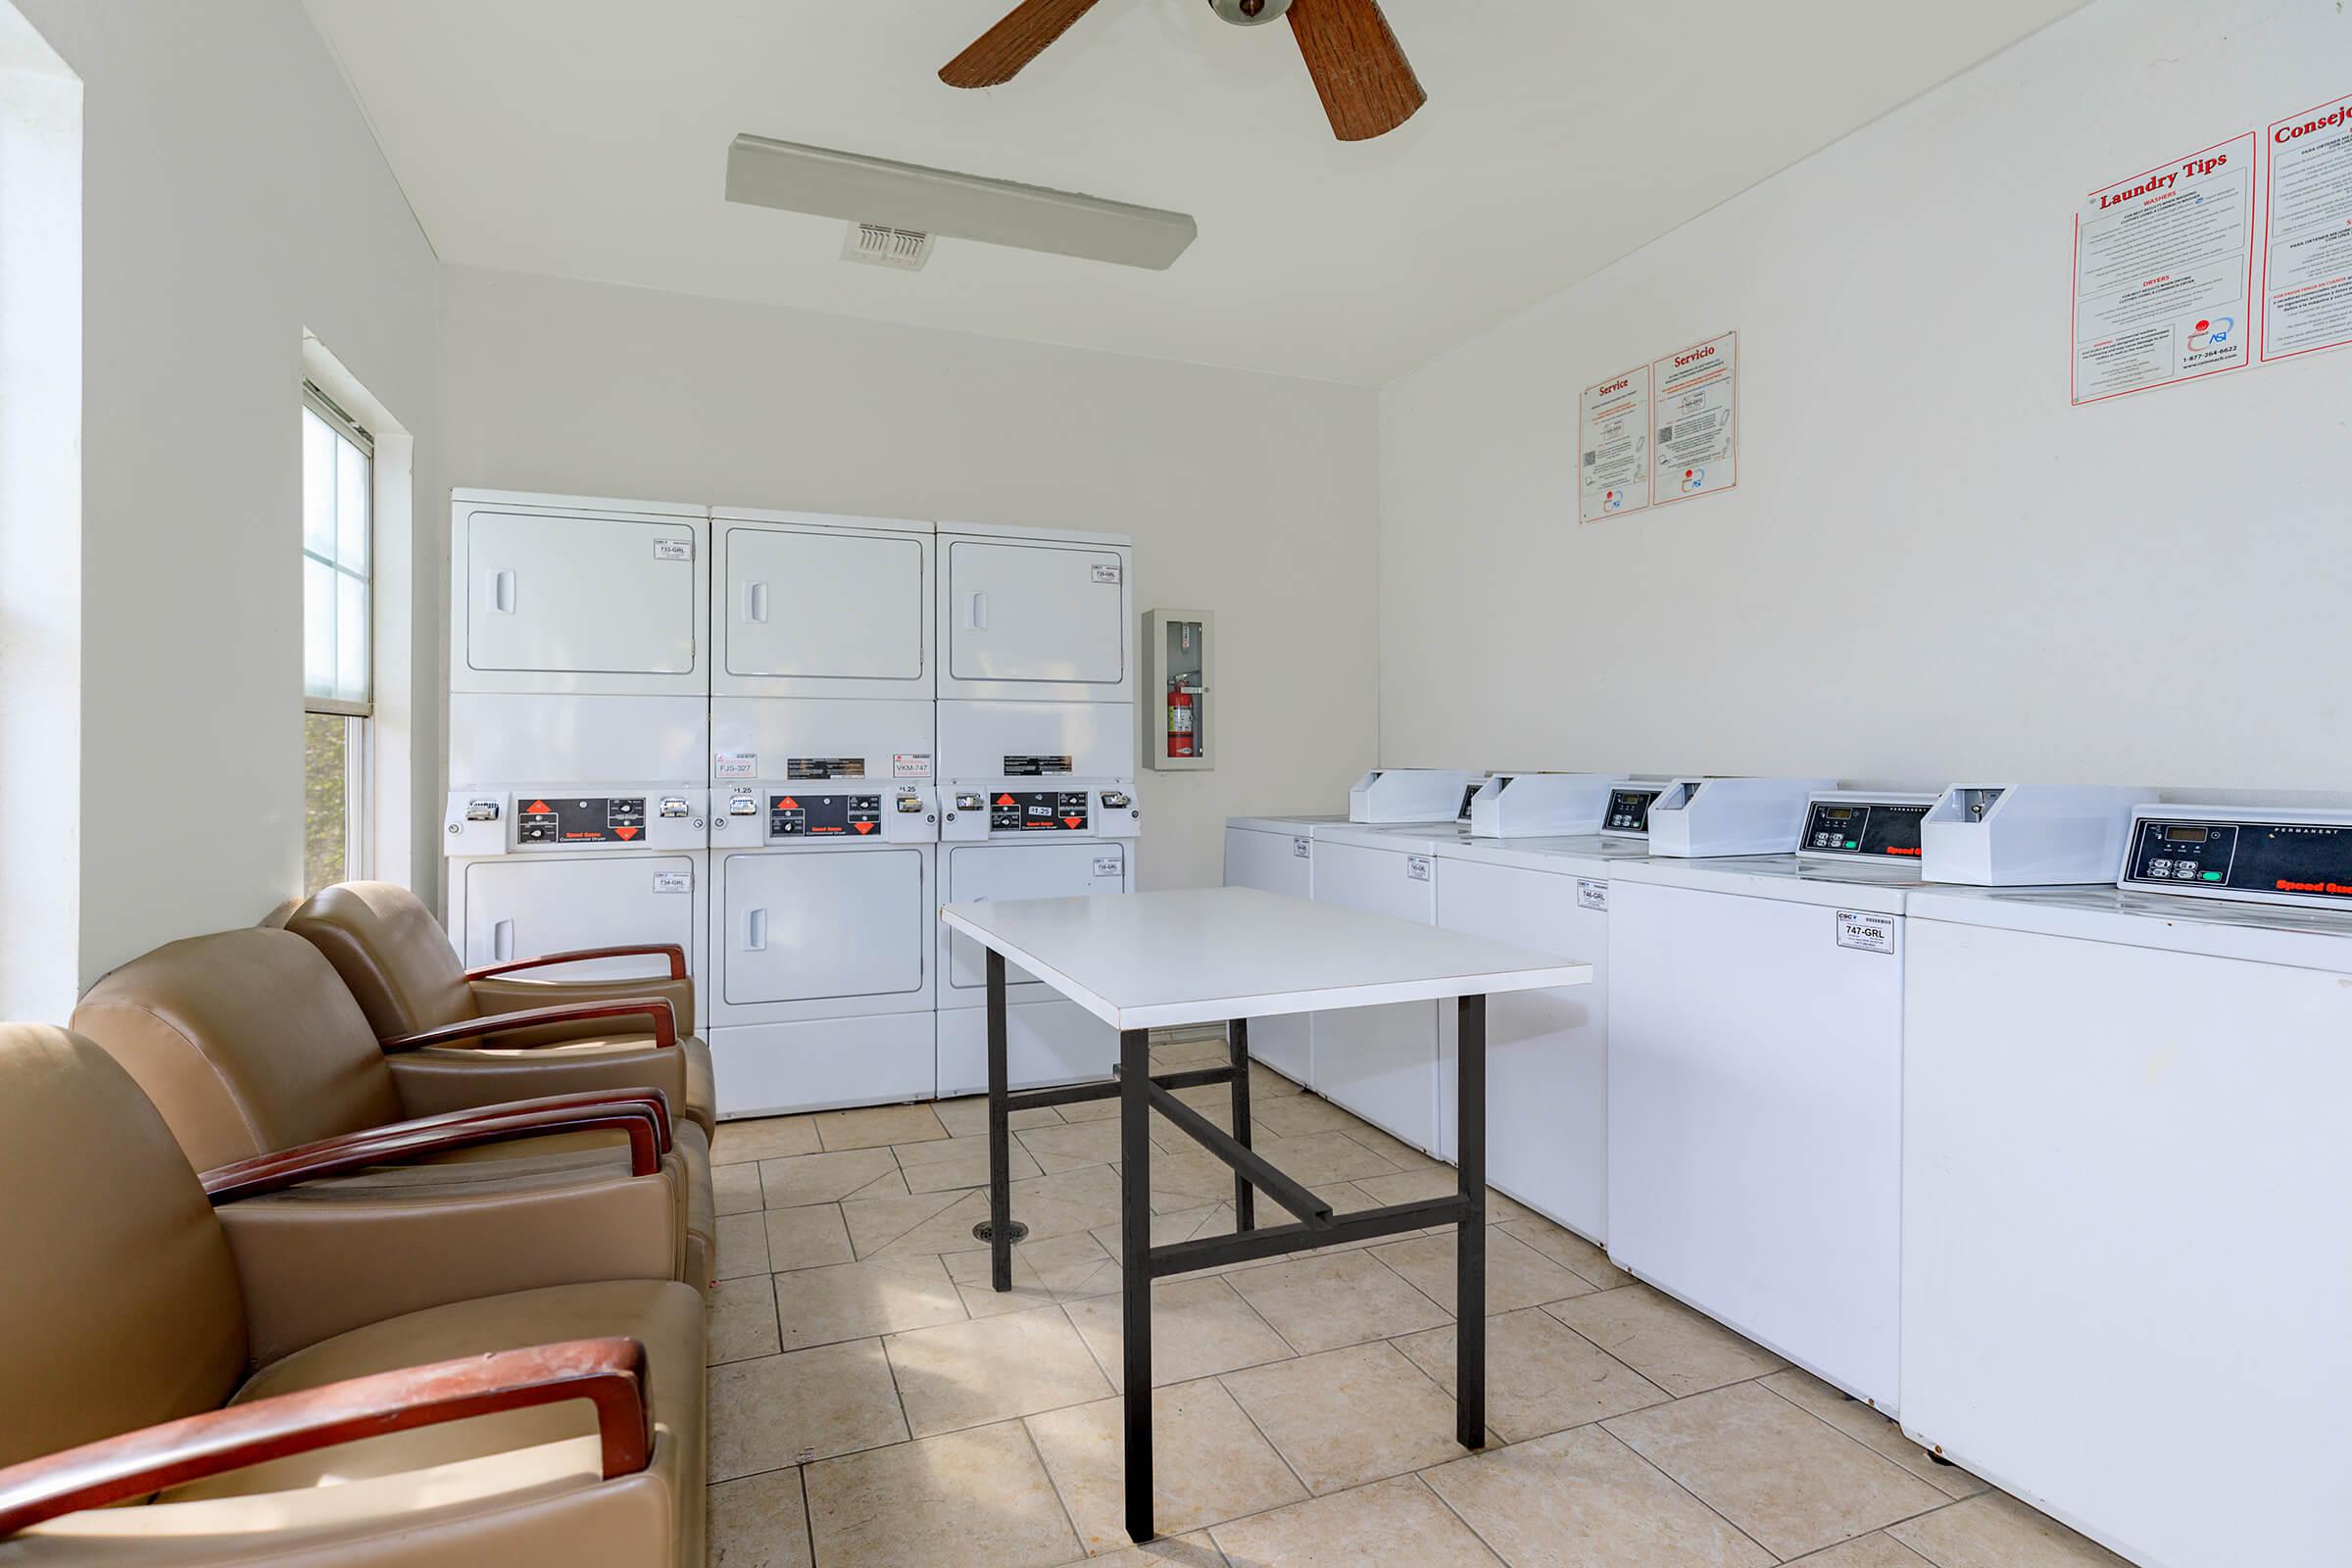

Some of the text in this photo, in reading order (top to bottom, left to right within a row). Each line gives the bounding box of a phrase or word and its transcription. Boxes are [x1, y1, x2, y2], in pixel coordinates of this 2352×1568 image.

[2099, 154, 2228, 210] Laundry Tips
[2143, 190, 2177, 207] WASHERS
[2142, 275, 2170, 288] DRYERS
[1674, 346, 1715, 368] Servicio
[1598, 379, 1629, 397] Service
[2276, 879, 2325, 891] Speed
[1846, 925, 1886, 939] 747-GRL
